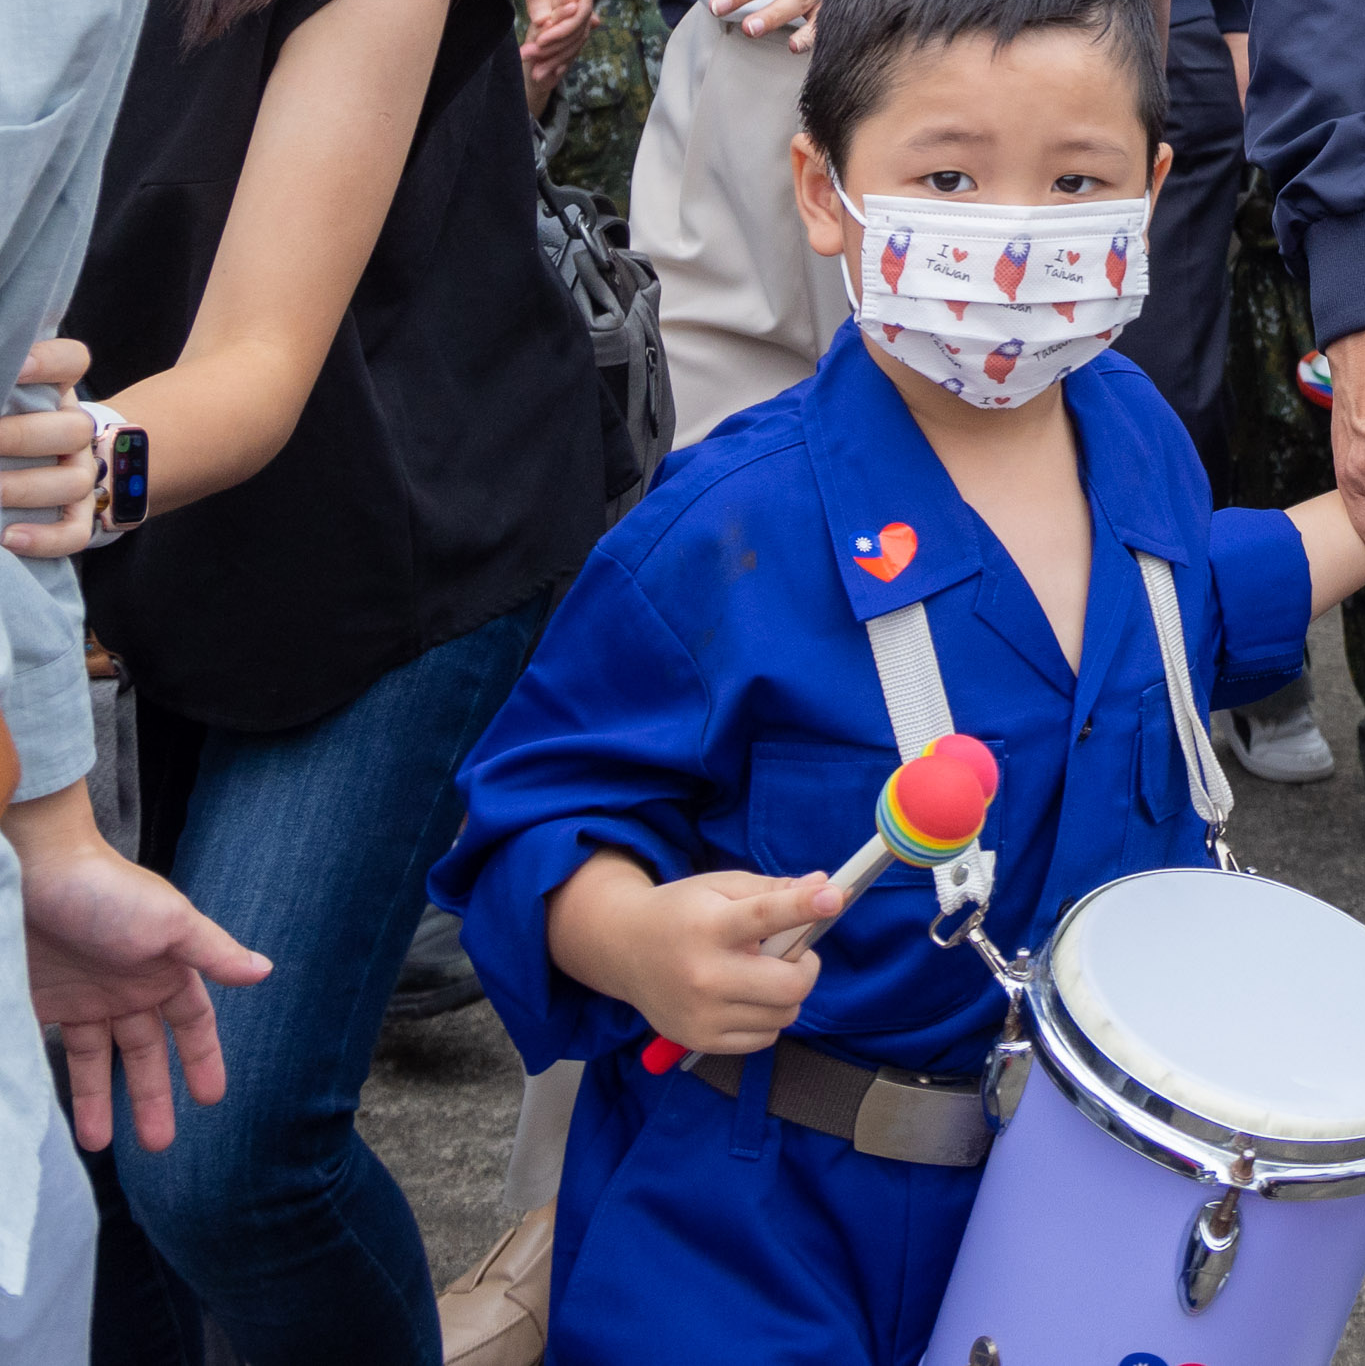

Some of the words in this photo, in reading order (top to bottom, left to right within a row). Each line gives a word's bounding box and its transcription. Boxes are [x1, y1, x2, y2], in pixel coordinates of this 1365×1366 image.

[937, 244, 949, 259] I
[1054, 249, 1065, 263] I
[926, 258, 970, 283] Taiwan
[1045, 265, 1084, 284] Taiwan
